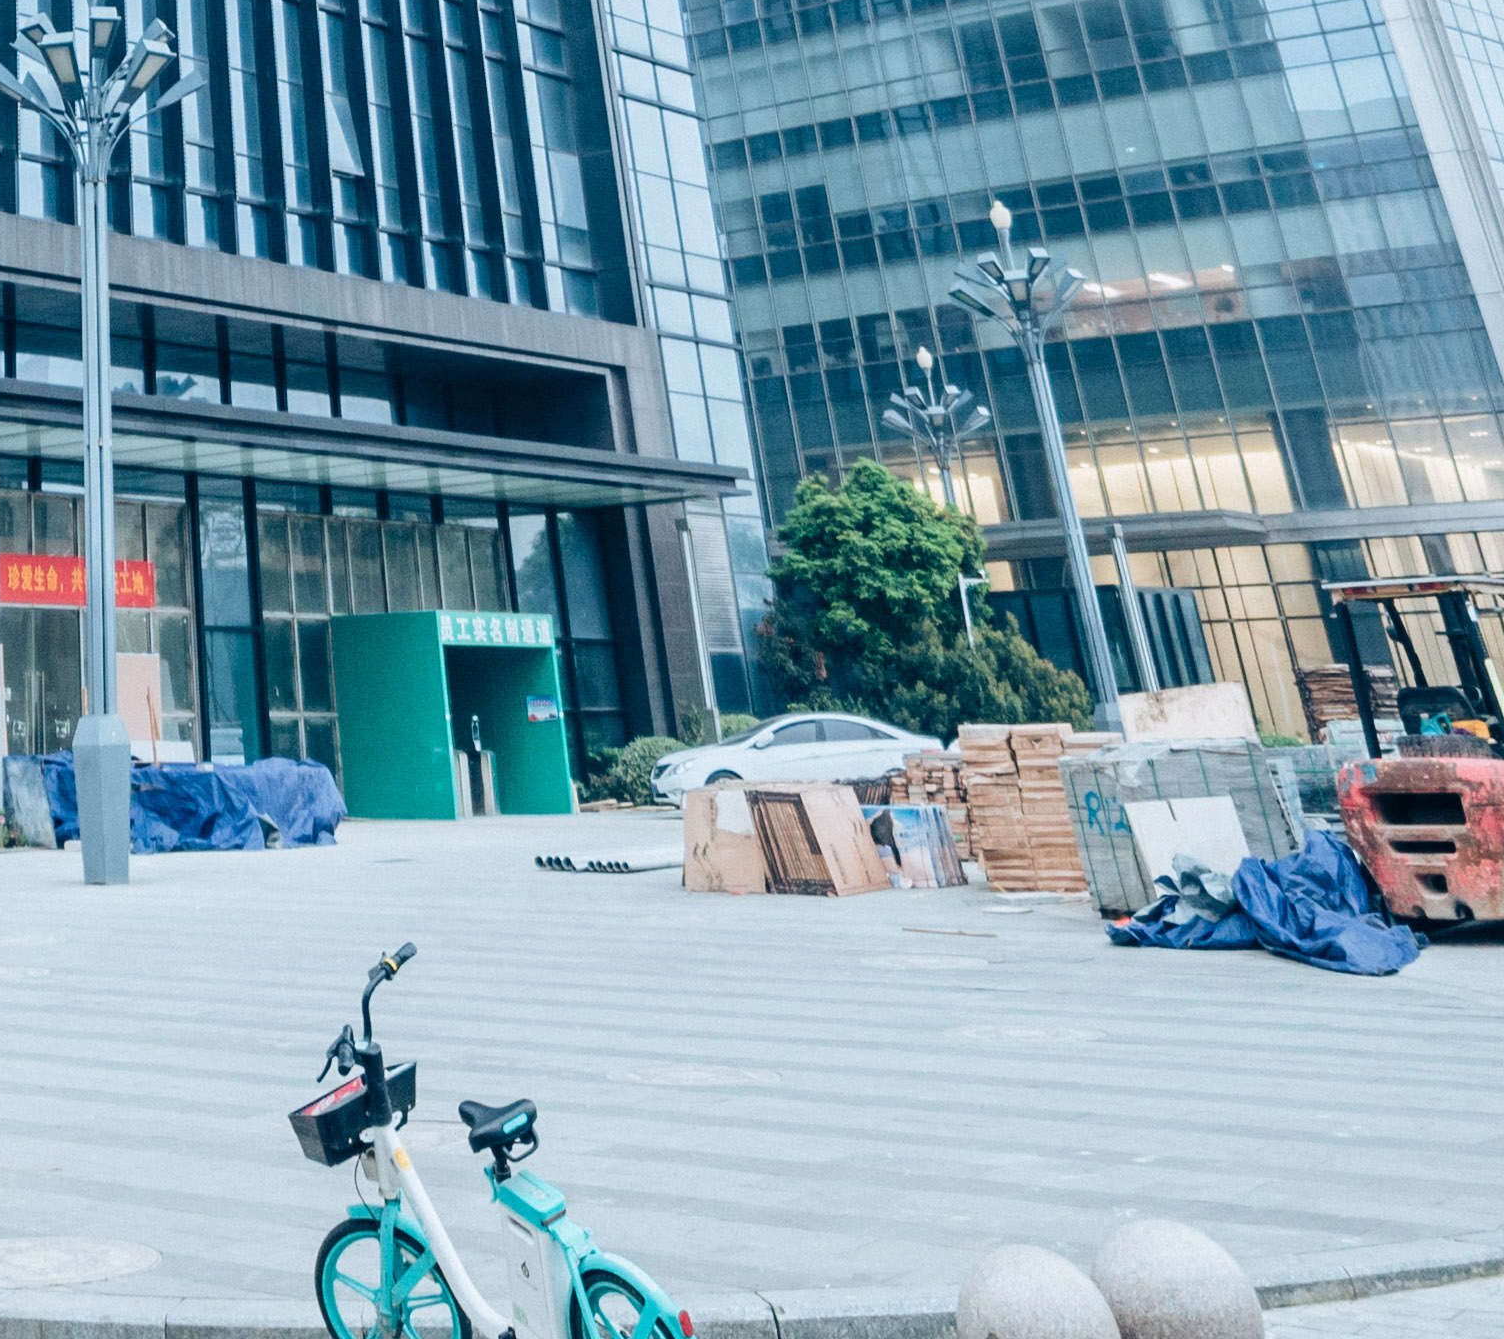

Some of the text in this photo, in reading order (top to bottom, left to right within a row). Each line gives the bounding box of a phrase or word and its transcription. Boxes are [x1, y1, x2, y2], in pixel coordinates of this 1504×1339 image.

[440, 615, 552, 644] 员工实名制通道
